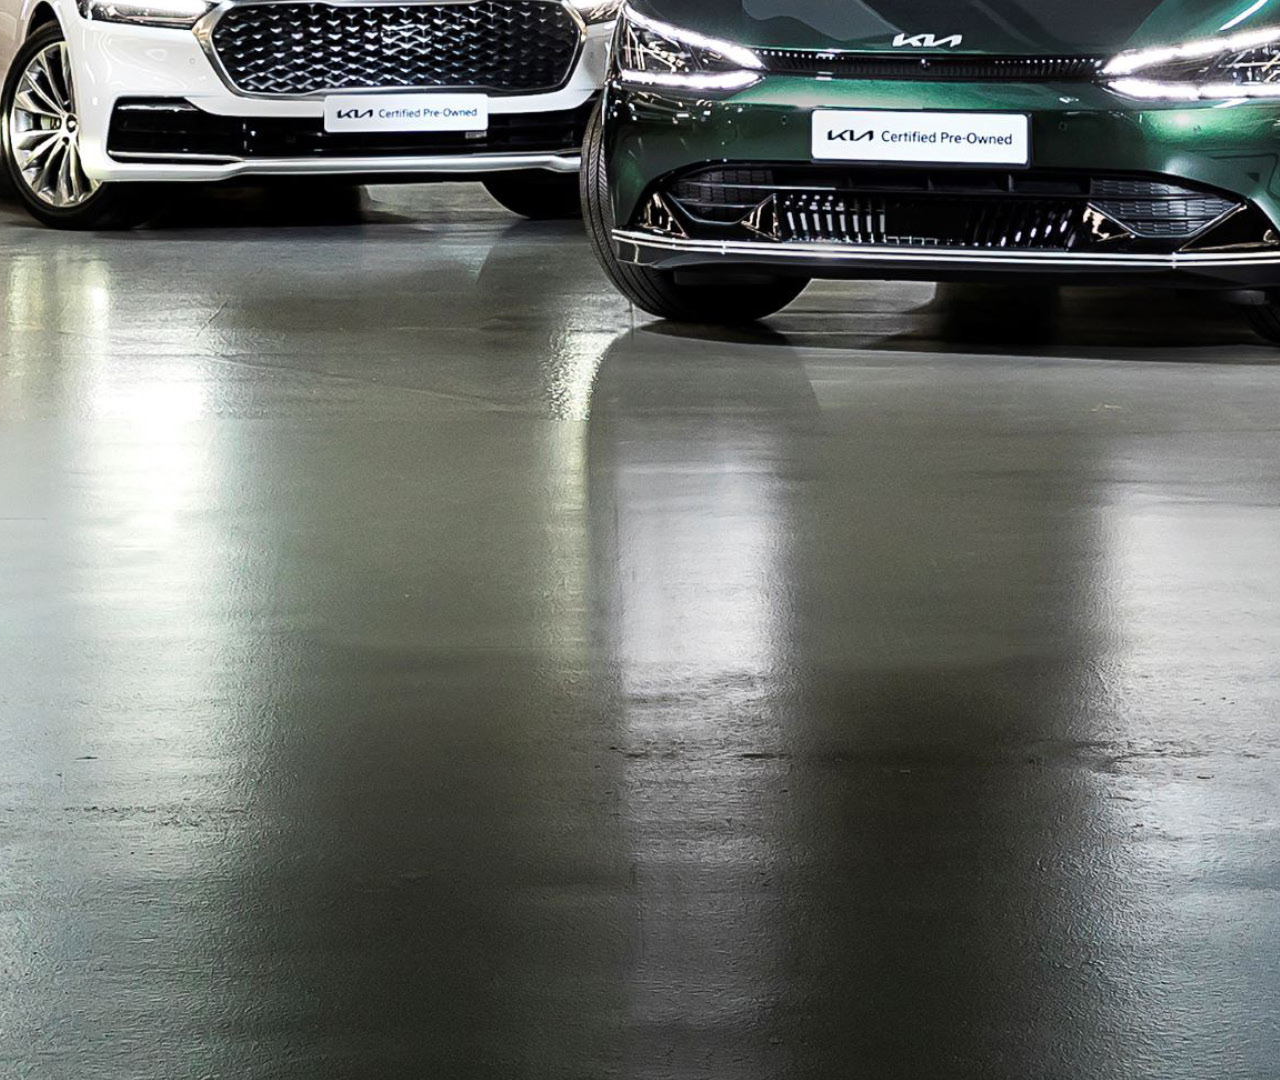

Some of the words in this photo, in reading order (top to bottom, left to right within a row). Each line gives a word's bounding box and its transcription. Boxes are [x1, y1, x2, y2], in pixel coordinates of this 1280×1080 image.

[378, 108, 421, 119] Certified
[423, 107, 478, 118] Pre-Owned
[881, 129, 937, 144] Certified
[940, 131, 1013, 146] Pre-Owned
